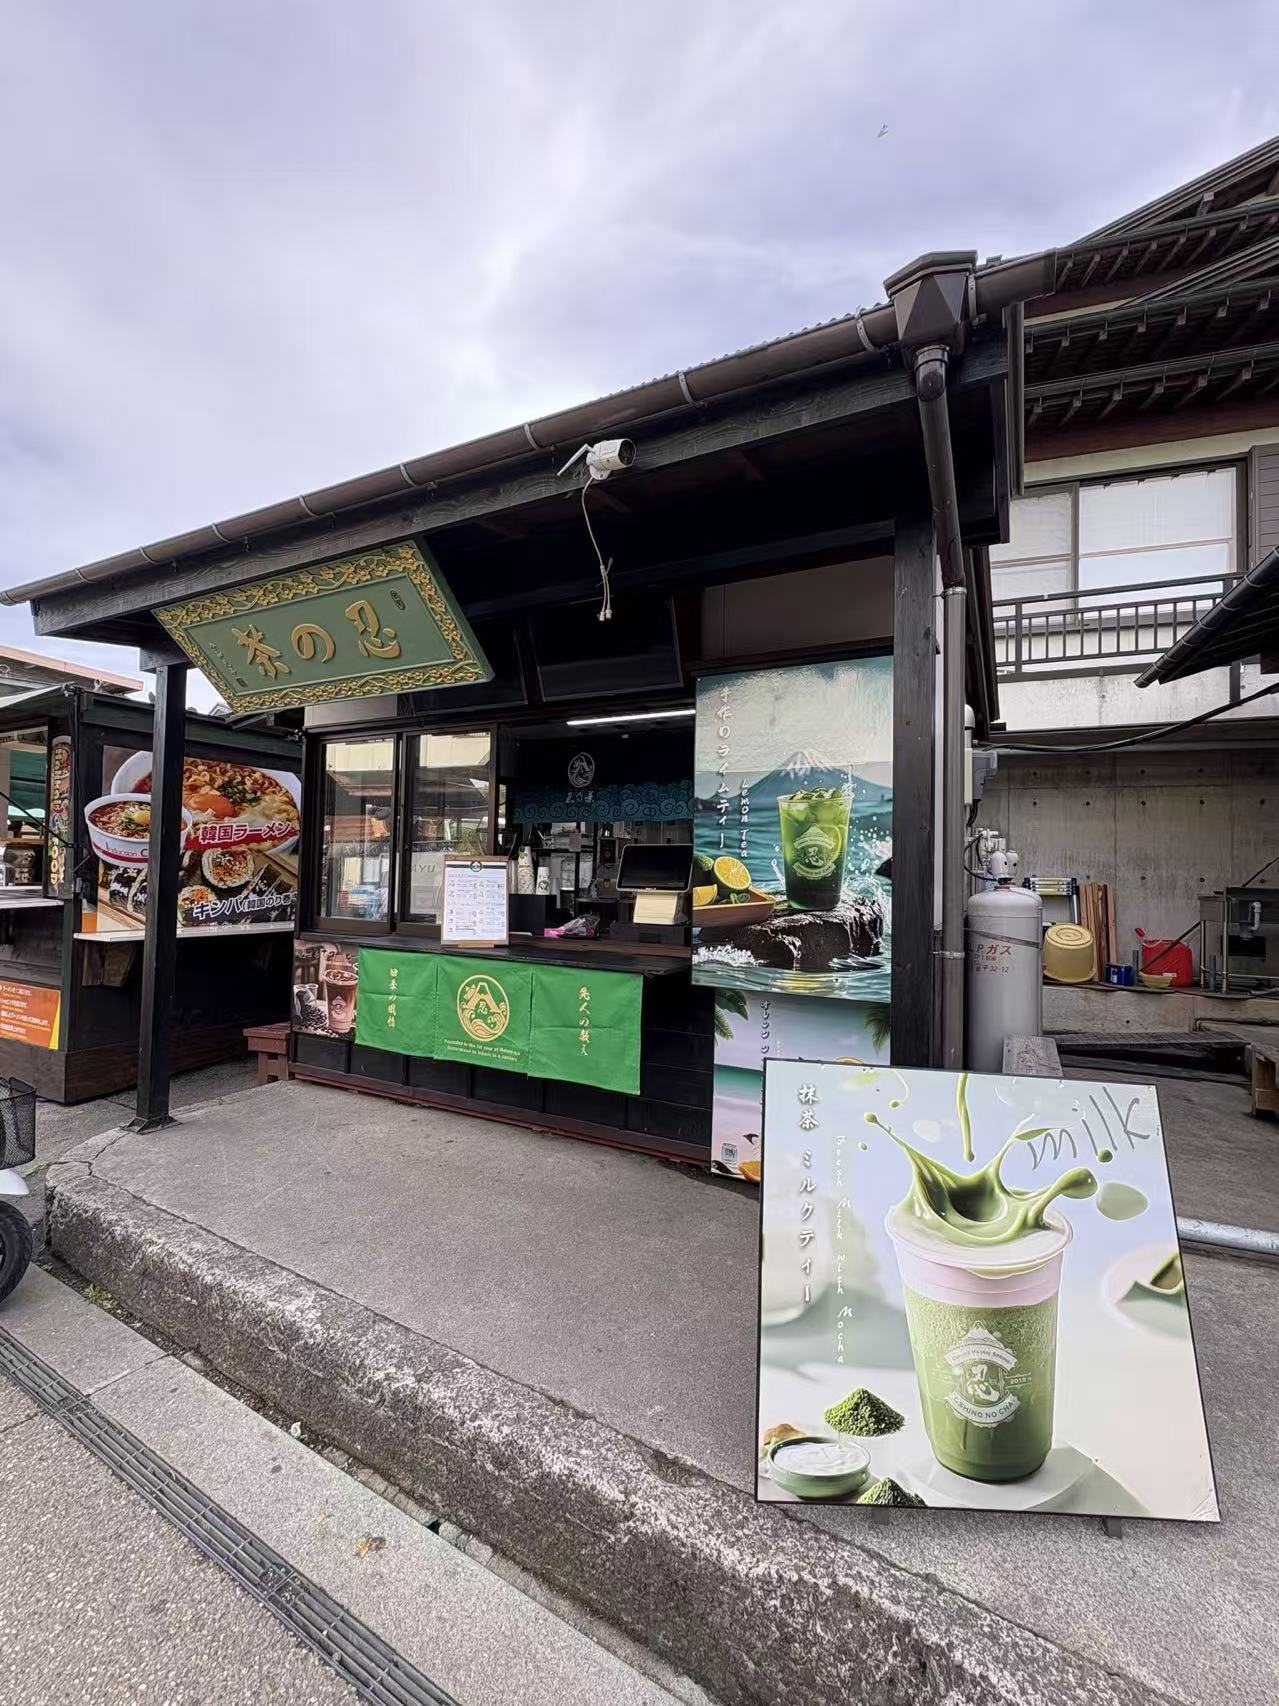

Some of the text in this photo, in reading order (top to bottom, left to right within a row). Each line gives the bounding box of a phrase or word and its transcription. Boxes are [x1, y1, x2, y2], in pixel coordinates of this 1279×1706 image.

[199, 822, 291, 844] 韓国ラーメン
[1027, 1086, 1151, 1171] milk
[799, 1084, 819, 1303] 抹茶 ミルクティー
[837, 1305, 853, 1364] Mocha
